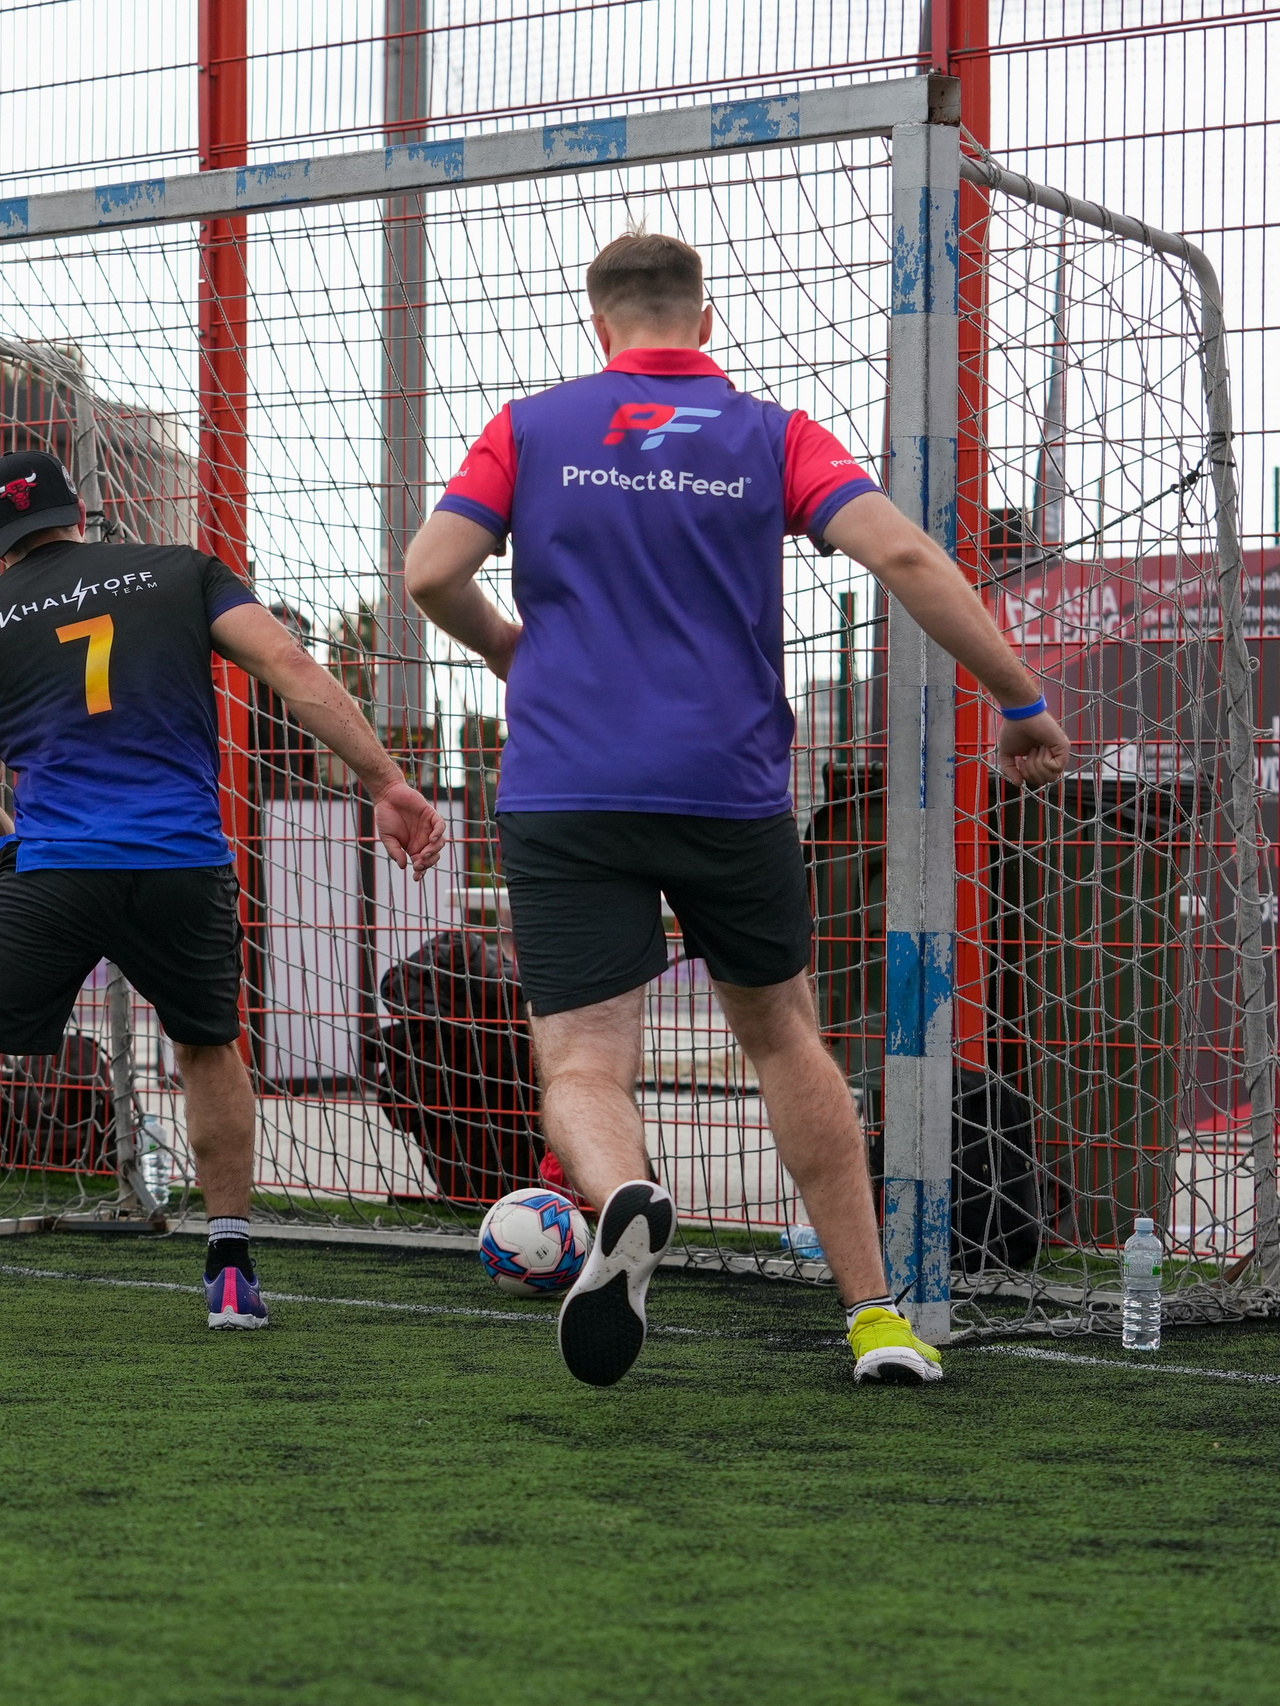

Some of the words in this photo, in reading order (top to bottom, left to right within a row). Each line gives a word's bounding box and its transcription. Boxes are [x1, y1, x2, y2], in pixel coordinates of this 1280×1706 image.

[111, 582, 158, 596] TEAM
[1055, 586, 1119, 614] ASIA
[55, 613, 115, 715] 7
